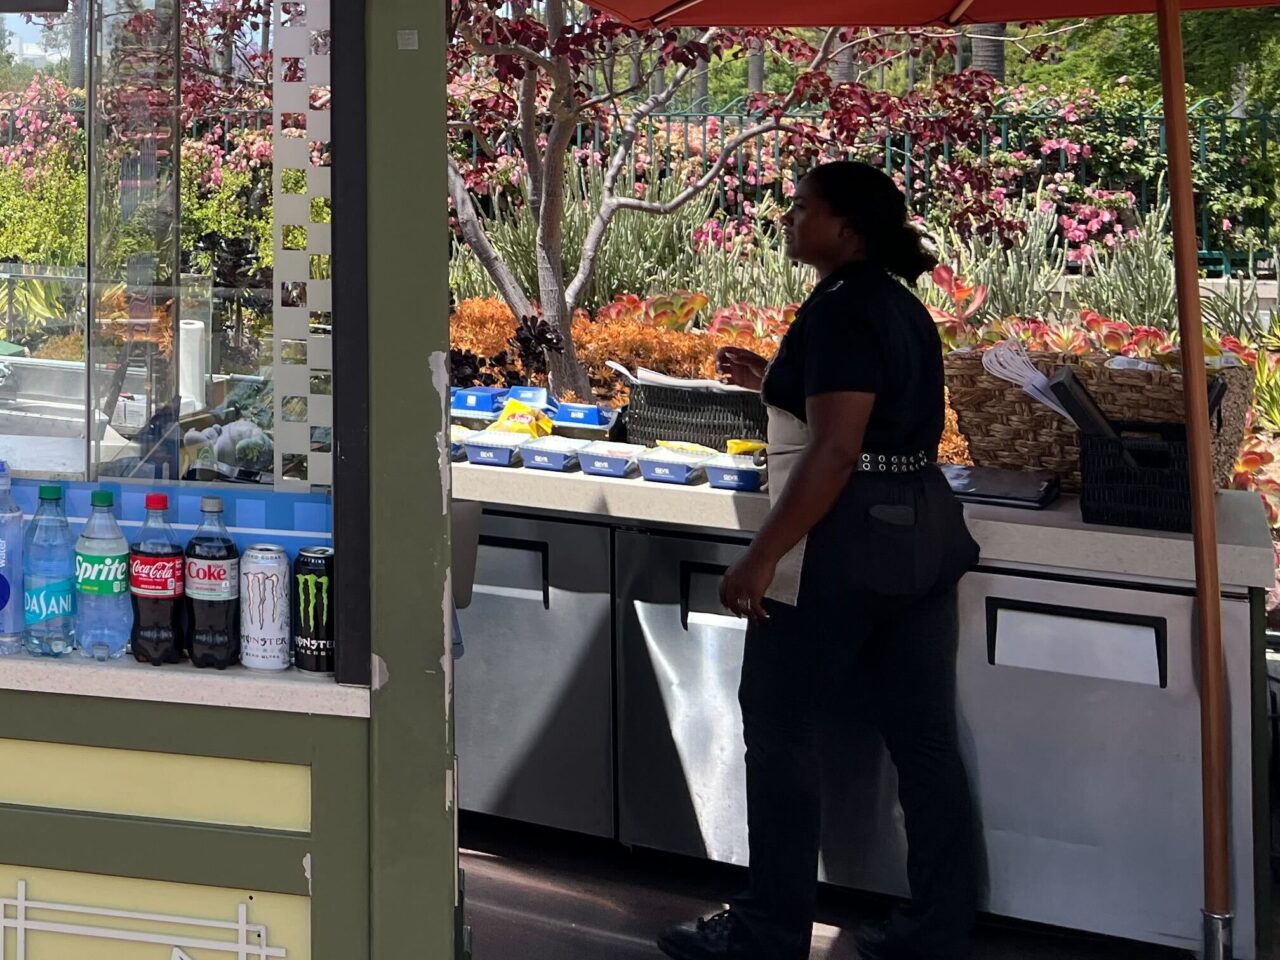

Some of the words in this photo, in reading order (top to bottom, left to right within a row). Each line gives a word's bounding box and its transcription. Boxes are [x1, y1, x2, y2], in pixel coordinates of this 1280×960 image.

[74, 555, 127, 582] Sprite
[132, 560, 175, 579] Coca-Cola
[188, 561, 227, 581] Coke
[24, 590, 72, 620] DASANI
[240, 634, 287, 647] MONSTER
